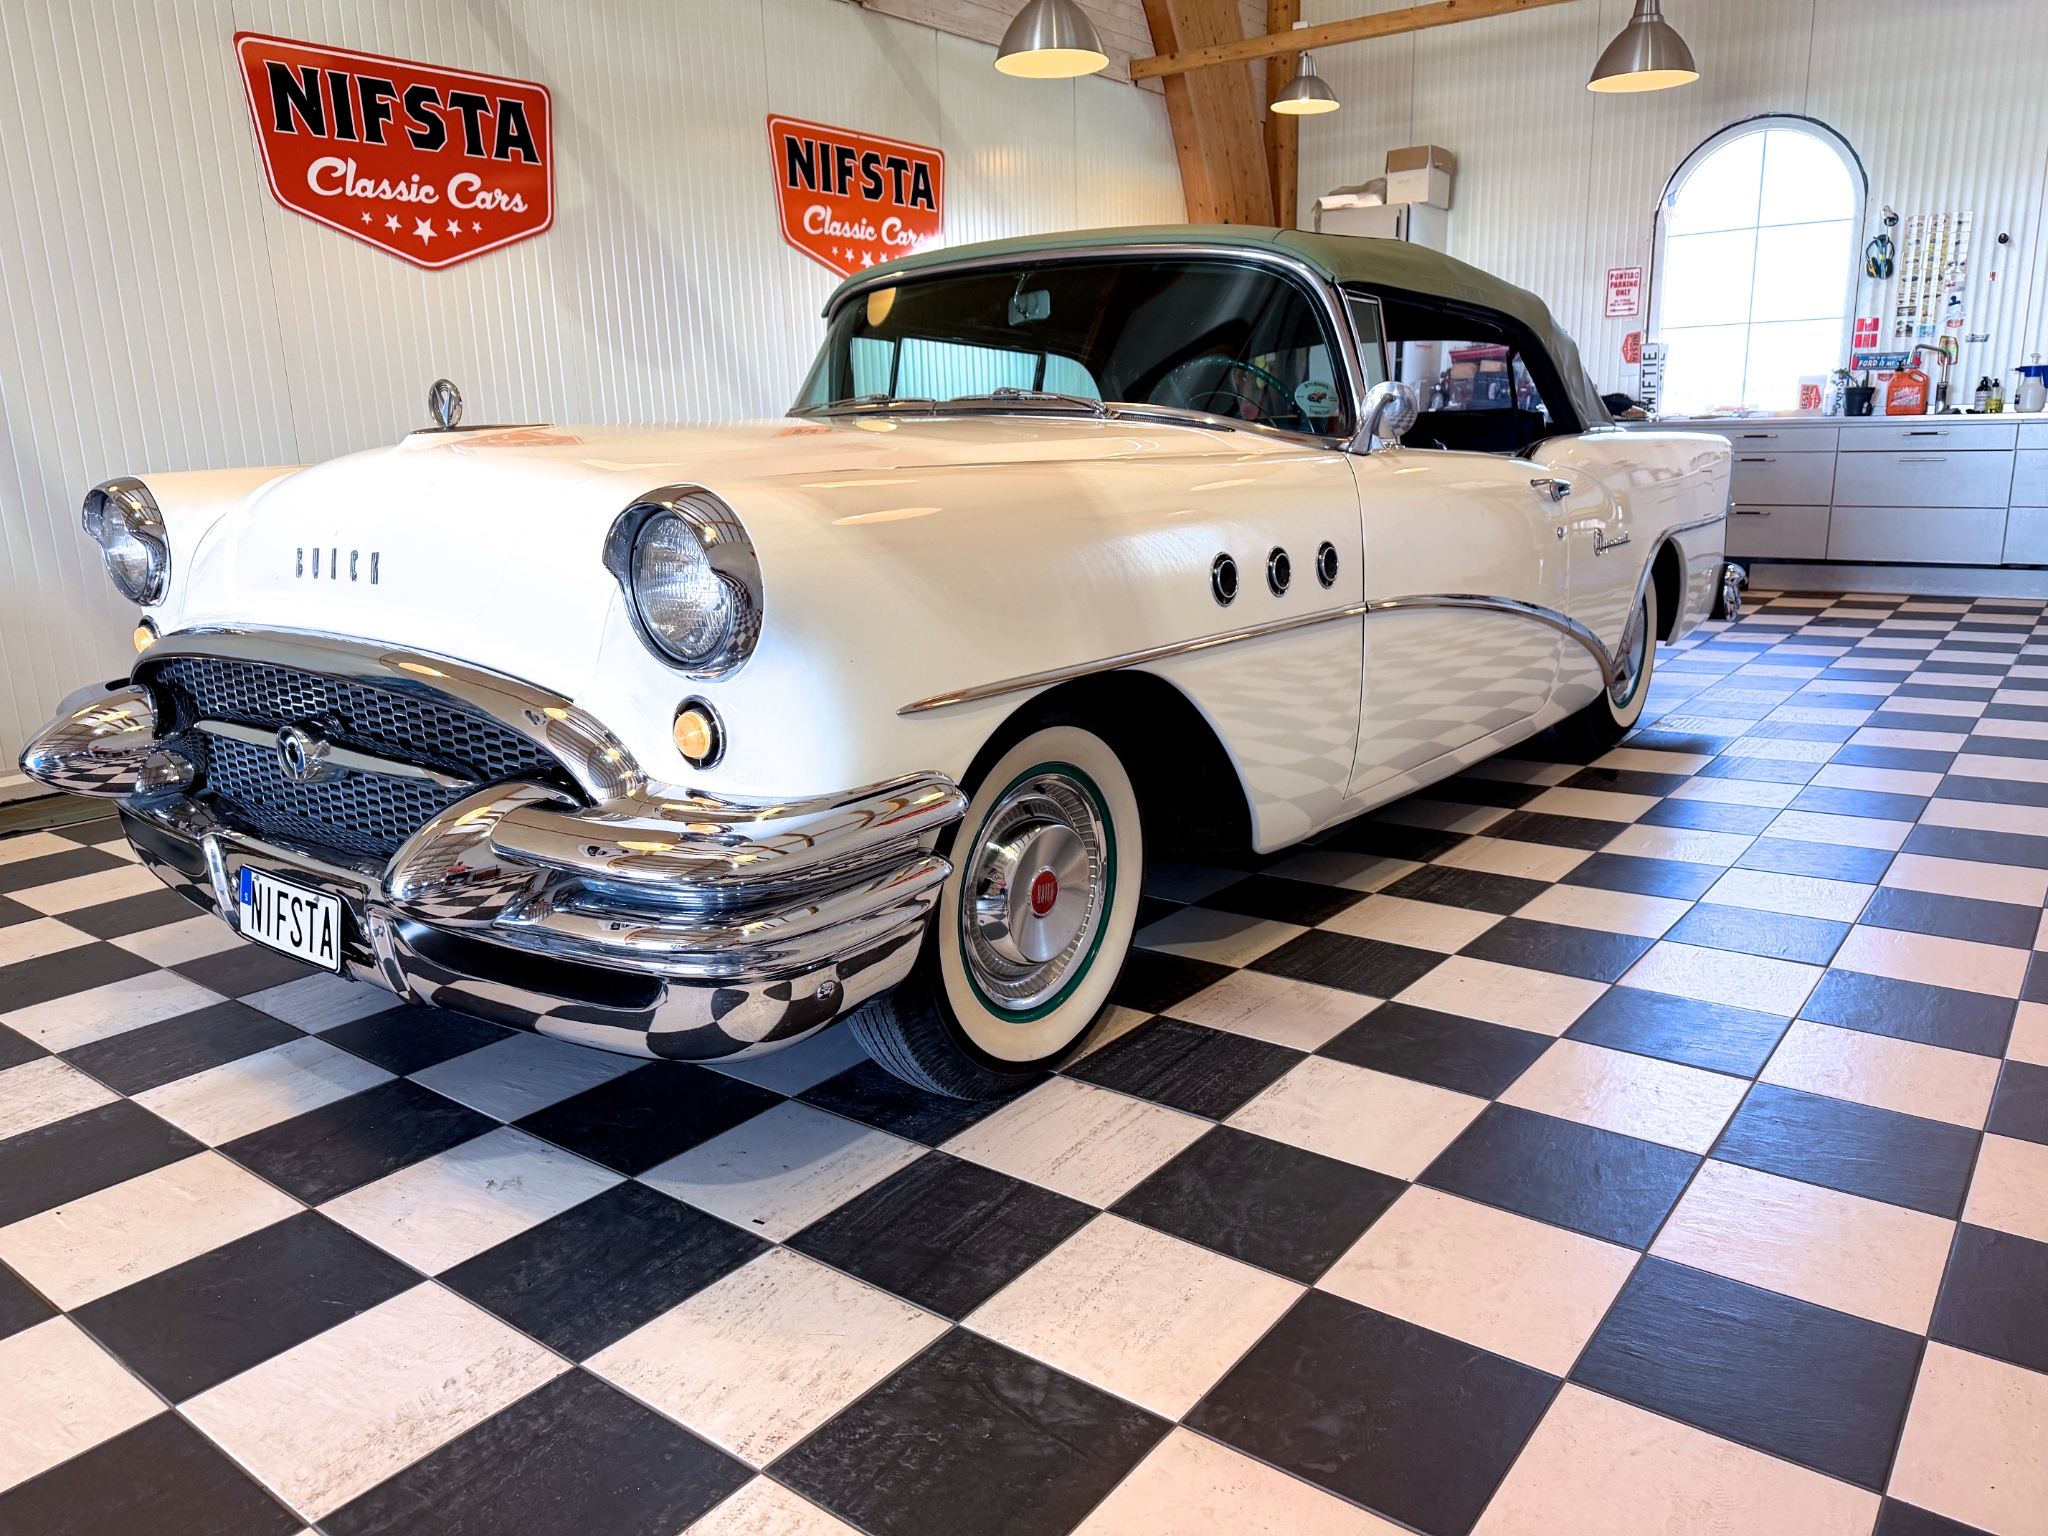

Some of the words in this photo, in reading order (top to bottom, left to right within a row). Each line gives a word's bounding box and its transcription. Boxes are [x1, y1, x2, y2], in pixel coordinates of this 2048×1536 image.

[263, 59, 542, 166] NIFSTA
[307, 156, 439, 204] Classic
[447, 171, 528, 213] Cars
[783, 134, 938, 213] NIFSTA
[803, 205, 877, 241] Classic
[881, 216, 926, 247] Cars
[1610, 272, 1639, 280] PONTIAC
[1610, 280, 1638, 288] PARKING
[1615, 288, 1631, 296] ONLY
[296, 547, 380, 585] BUICK
[244, 892, 249, 902] S
[251, 880, 334, 961] NIFSTA
